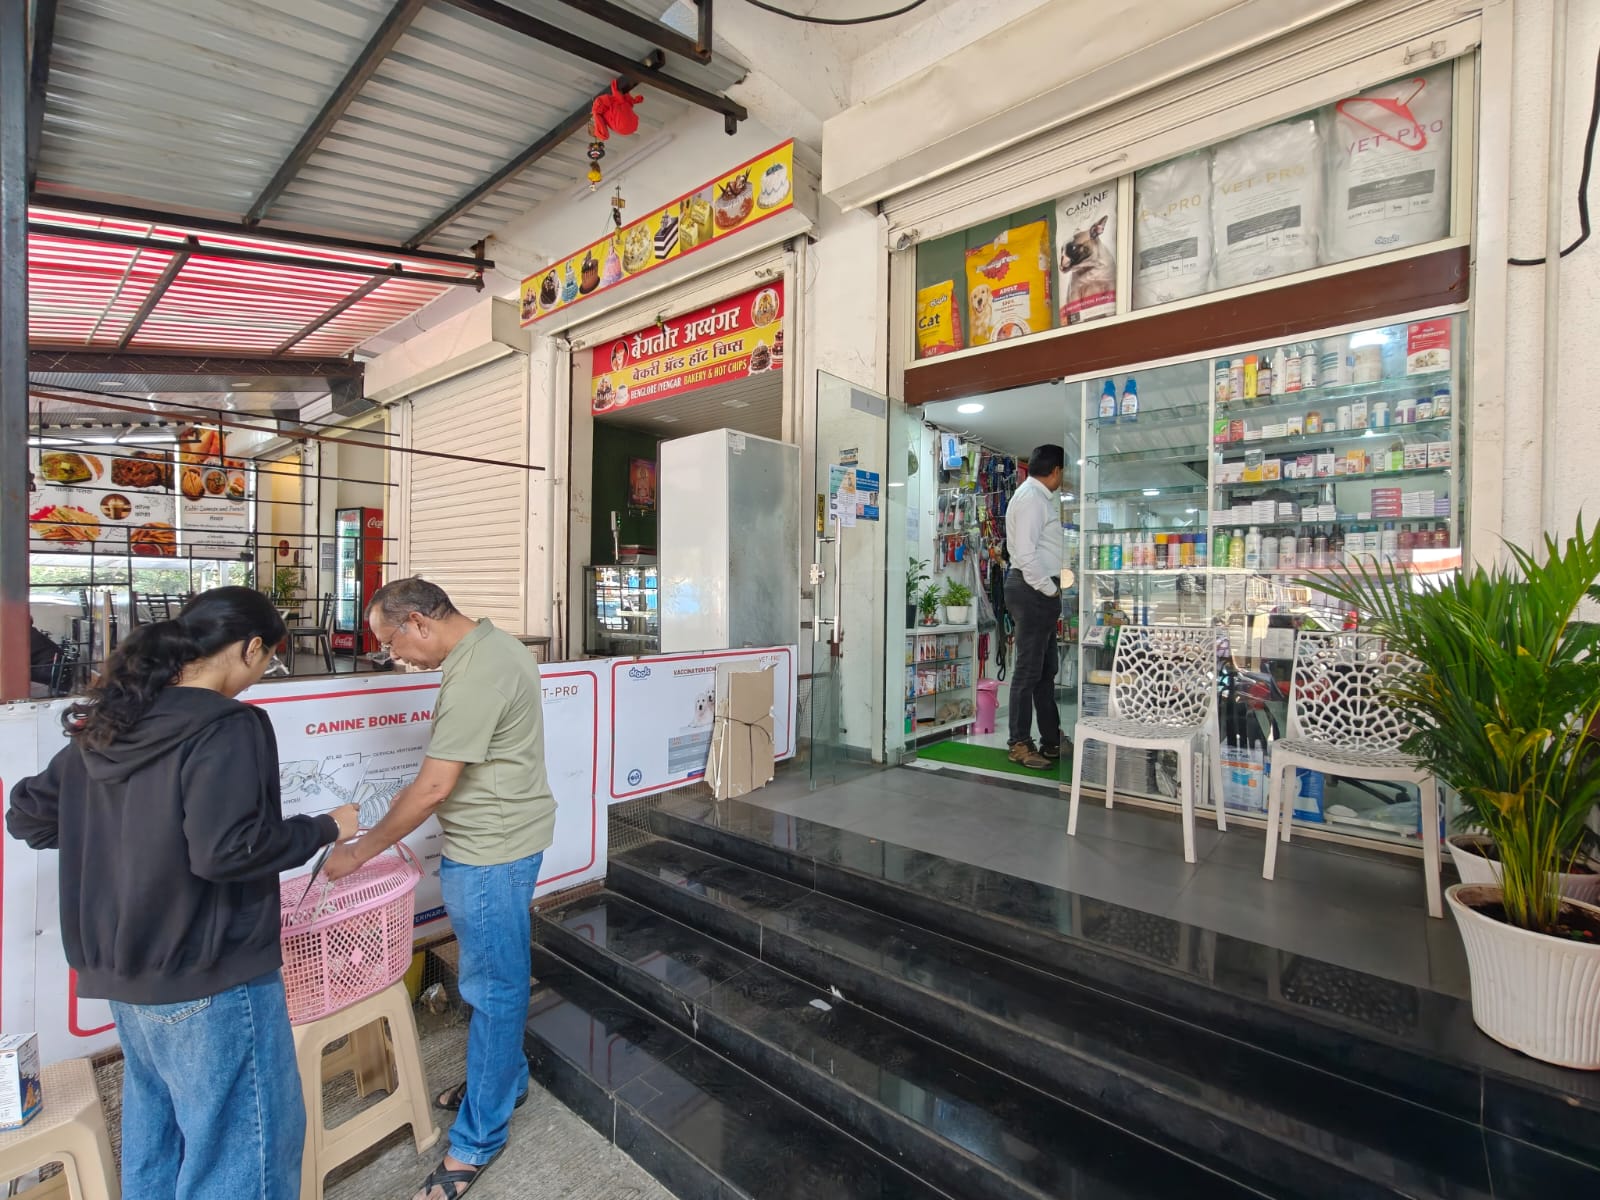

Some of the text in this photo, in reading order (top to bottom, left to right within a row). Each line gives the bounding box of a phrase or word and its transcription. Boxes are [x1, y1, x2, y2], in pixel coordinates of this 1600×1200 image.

[1066, 190, 1109, 216] CANINE
[918, 313, 941, 330] Cat
[633, 361, 660, 381] बेकरी
[689, 347, 709, 367] हॉट
[713, 338, 745, 359] चिप्स
[630, 384, 657, 400] BENGLORE
[657, 377, 682, 392] IYENGAR
[683, 369, 707, 386] BAKERY
[714, 364, 727, 377] HOT
[727, 359, 748, 374] CHIPS
[629, 666, 651, 679] drools
[673, 667, 706, 676] VACCINATION
[542, 685, 578, 699] T-PRO
[305, 718, 365, 735] CANINE
[368, 713, 407, 728] BONE
